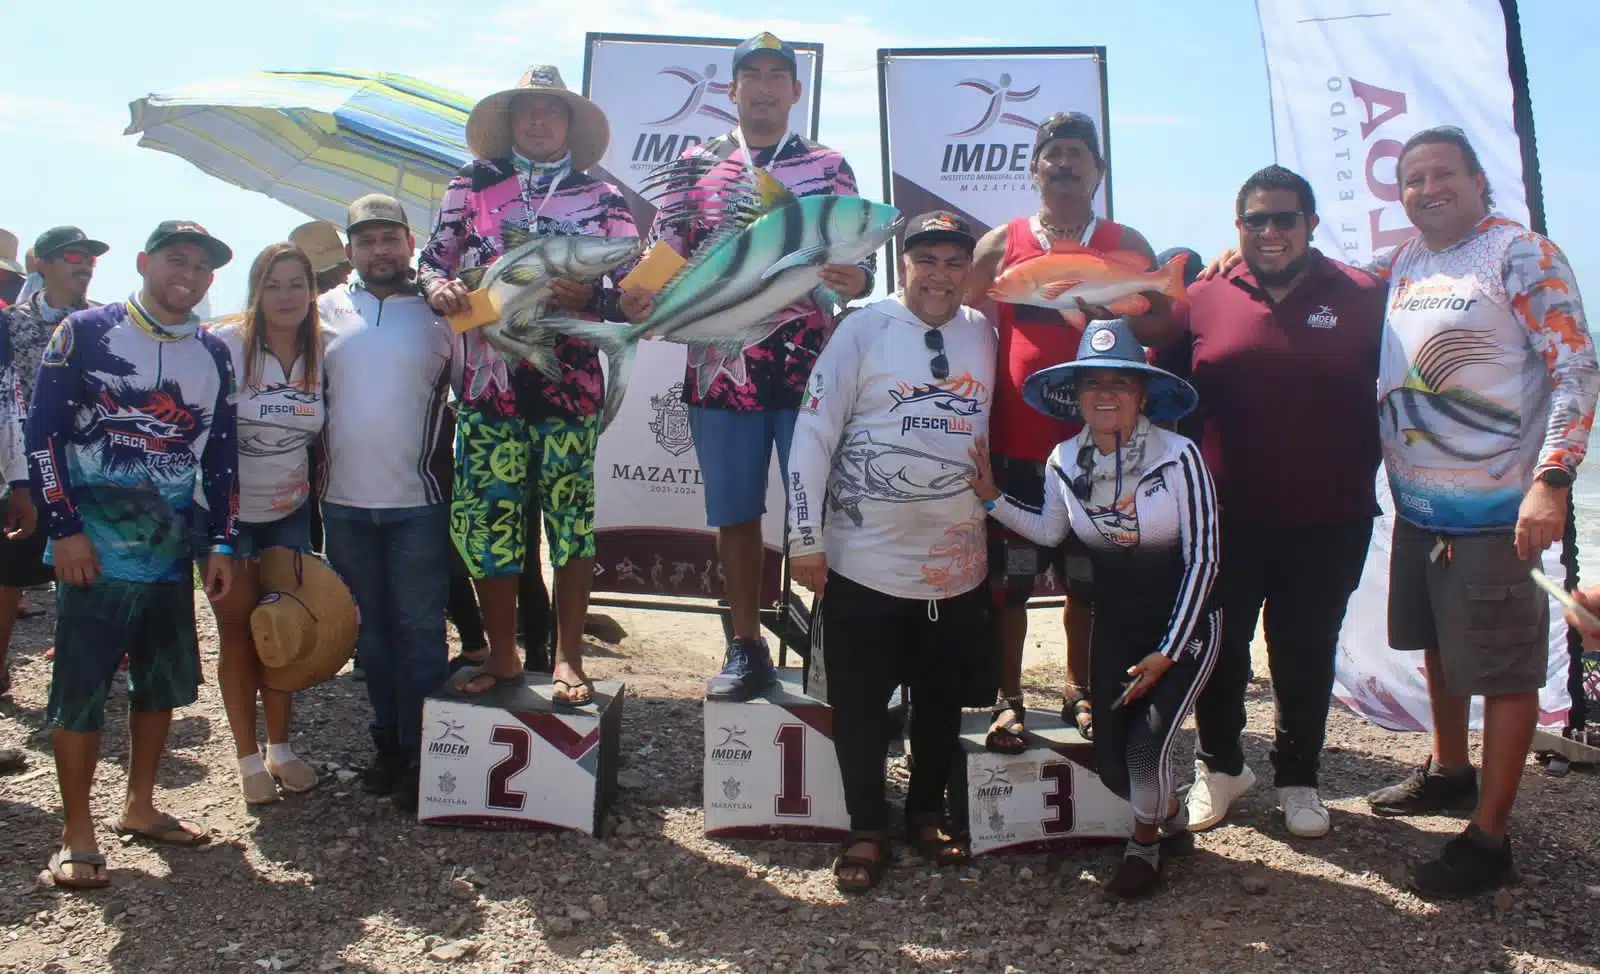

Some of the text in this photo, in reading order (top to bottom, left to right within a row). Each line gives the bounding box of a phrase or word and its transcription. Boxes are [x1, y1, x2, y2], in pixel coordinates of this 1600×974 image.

[941, 143, 1038, 172] IMDE
[611, 463, 704, 485] MAZATL
[429, 741, 470, 755] IMDEM
[711, 748, 753, 760] IMDEM
[486, 724, 532, 812] 2
[773, 723, 812, 817] 1
[977, 786, 1014, 799] IMDEM
[1039, 761, 1076, 837] 3
